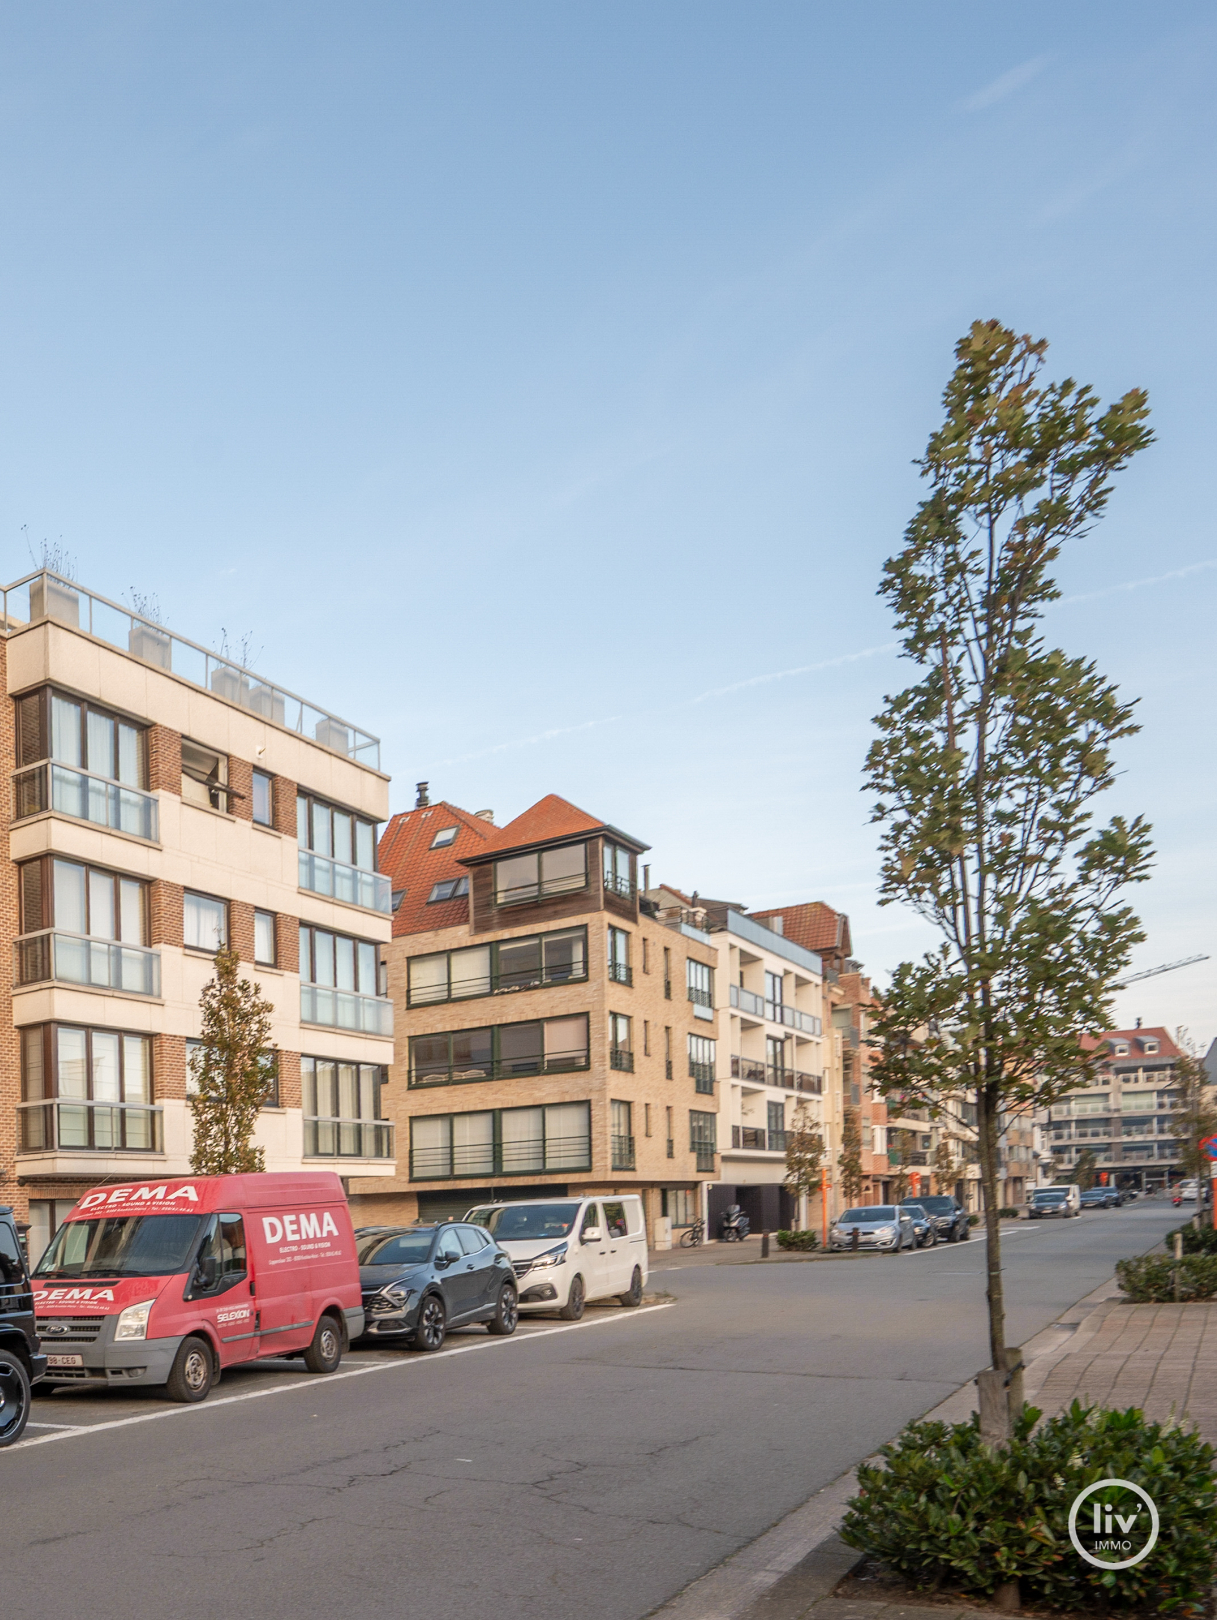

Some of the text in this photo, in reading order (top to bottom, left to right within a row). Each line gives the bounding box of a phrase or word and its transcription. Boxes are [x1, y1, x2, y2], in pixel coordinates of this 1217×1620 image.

[79, 1185, 199, 1210] DEMA
[262, 1211, 339, 1244] DEMA
[32, 1288, 114, 1301] DEMA
[48, 1356, 76, 1365] 98-CEG
